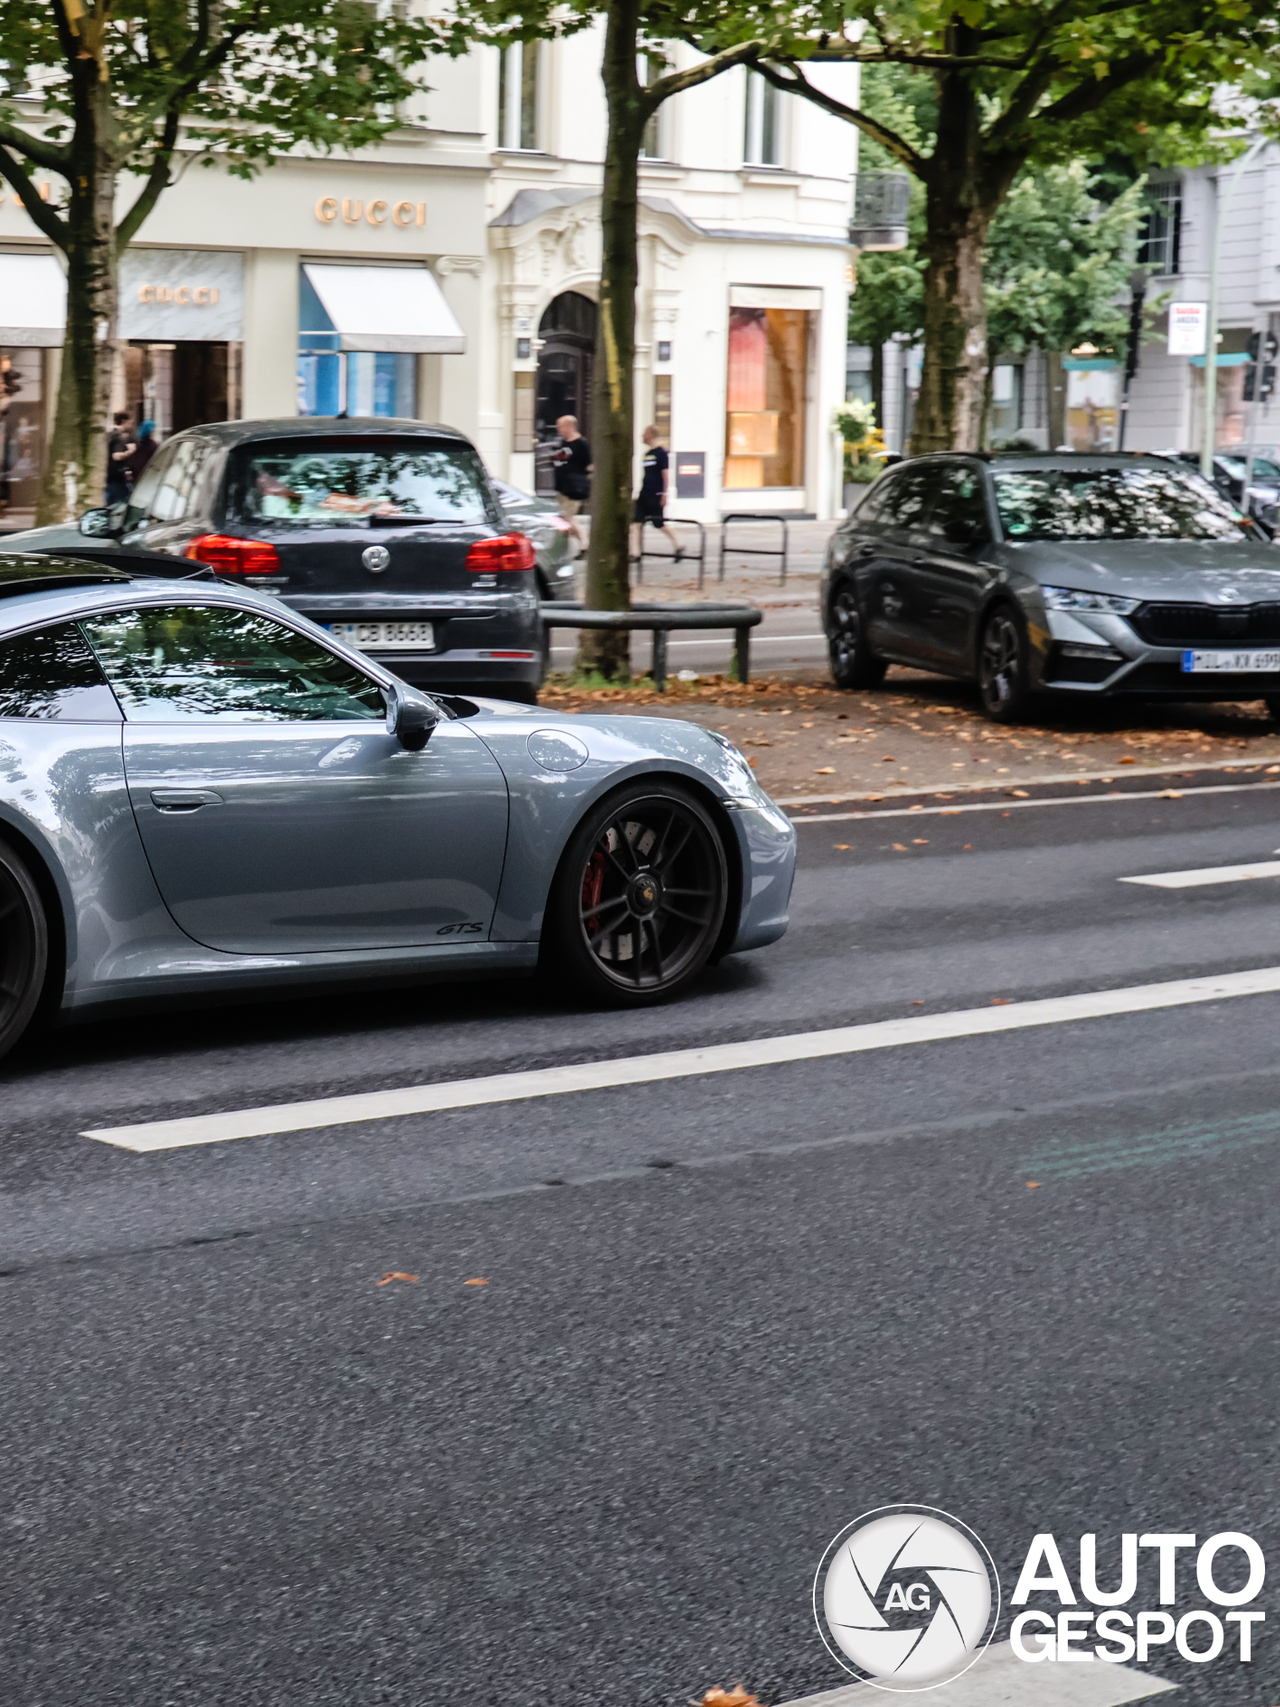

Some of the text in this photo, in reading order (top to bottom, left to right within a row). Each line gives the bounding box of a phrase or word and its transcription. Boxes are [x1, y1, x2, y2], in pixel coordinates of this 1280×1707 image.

[314, 197, 426, 228] GUCCI
[138, 284, 219, 305] GUCCI
[436, 922, 484, 935] GTS
